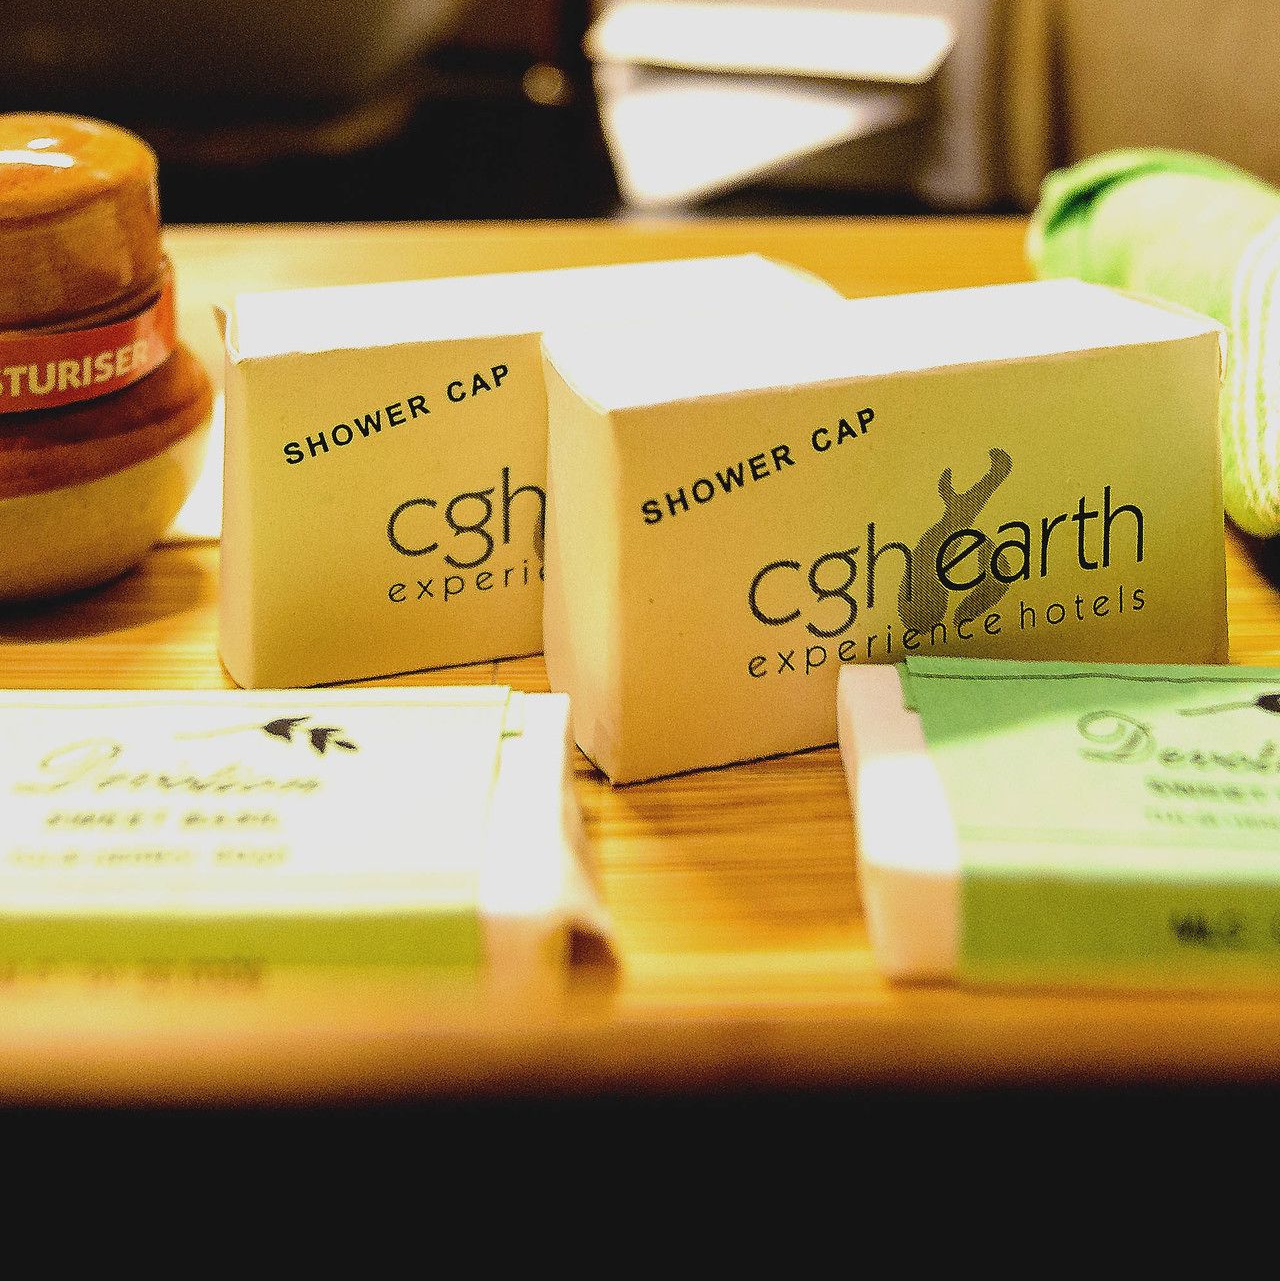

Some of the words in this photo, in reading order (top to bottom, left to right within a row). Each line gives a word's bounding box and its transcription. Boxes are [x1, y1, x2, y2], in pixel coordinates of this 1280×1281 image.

[283, 394, 431, 465] SHOWER
[445, 363, 510, 403] CAP
[386, 465, 546, 570] cgh
[640, 443, 796, 526] SHOWER
[811, 407, 876, 453] CAP
[387, 559, 546, 603] experi
[747, 521, 914, 639] cgh
[934, 485, 1145, 592] earth
[746, 611, 1003, 679] experience
[1019, 584, 1148, 631] hotels
